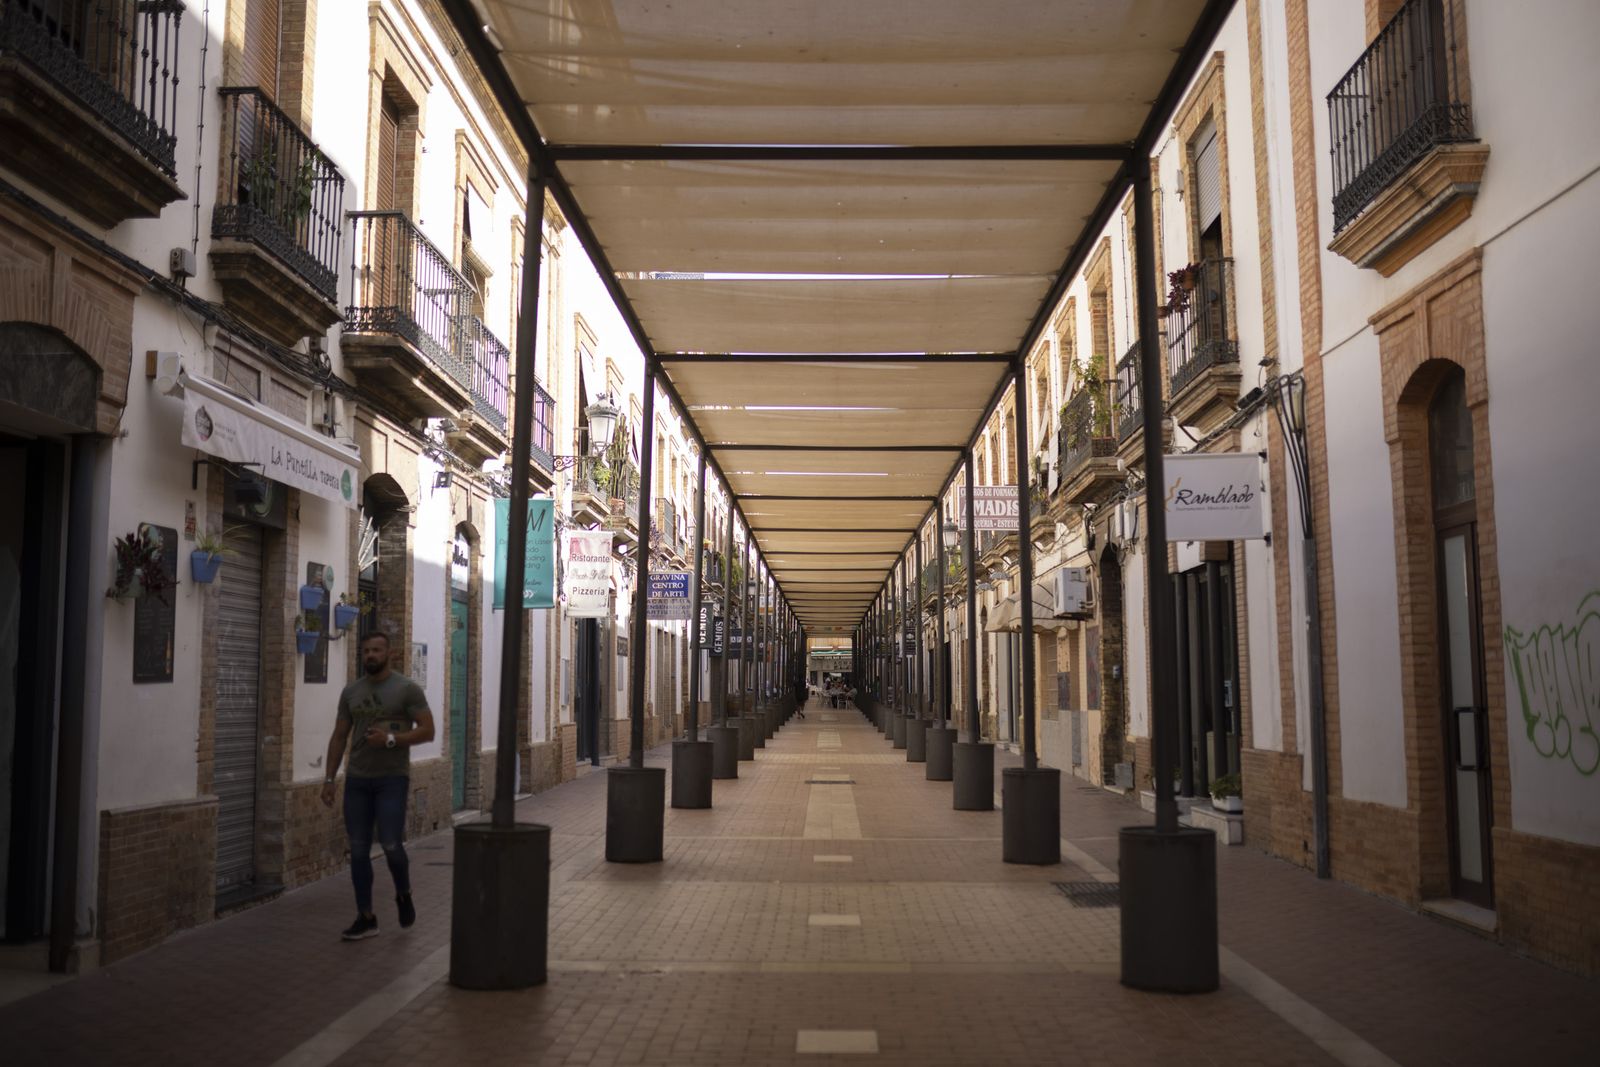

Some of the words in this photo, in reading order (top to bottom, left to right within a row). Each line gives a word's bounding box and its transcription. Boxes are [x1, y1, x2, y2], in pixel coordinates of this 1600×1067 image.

[1174, 484, 1254, 505] Ramblado
[998, 519, 1019, 528] ESTETIC
[571, 553, 610, 563] Ristorante
[572, 586, 605, 596] Pizzeria
